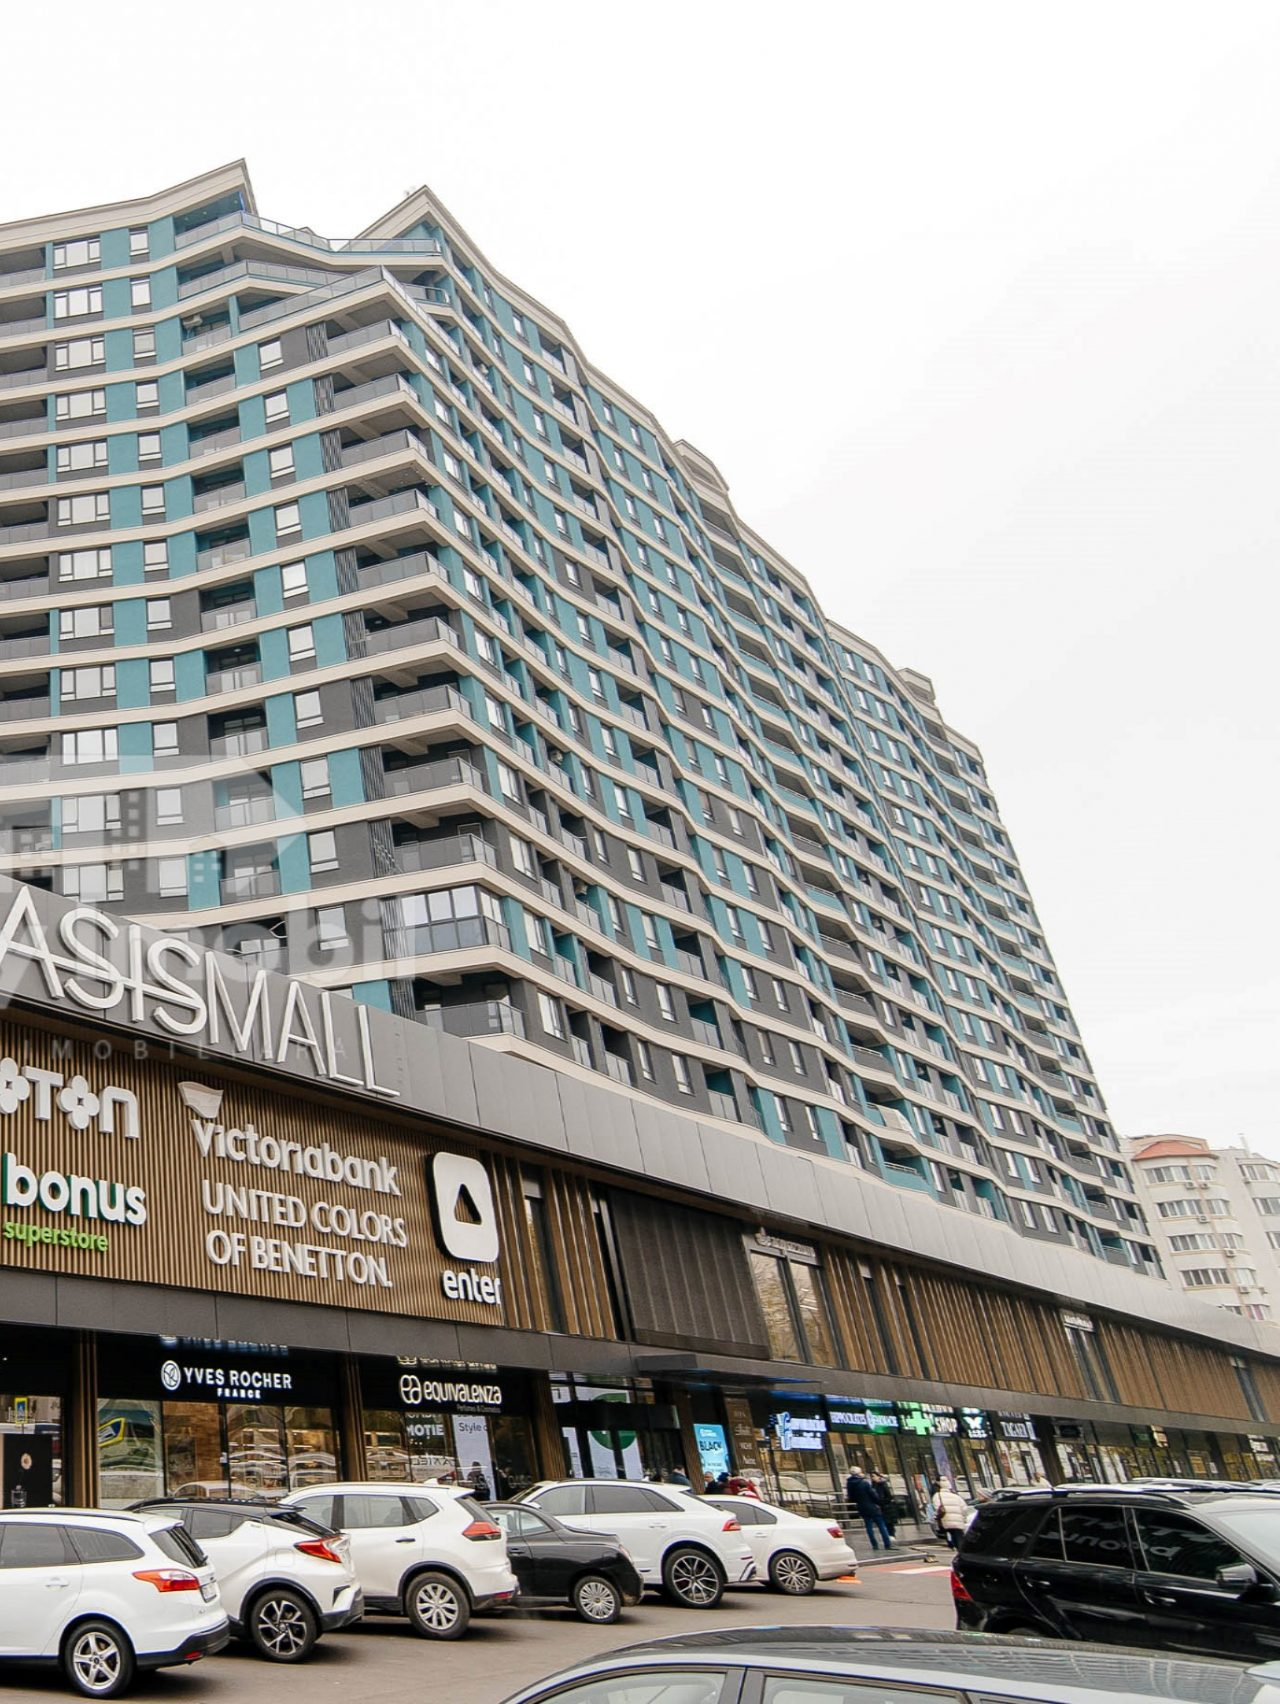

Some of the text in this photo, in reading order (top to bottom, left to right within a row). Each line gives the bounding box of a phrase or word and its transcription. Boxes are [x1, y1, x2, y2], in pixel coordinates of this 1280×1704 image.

[189, 1118, 402, 1197] Victoriabank
[1, 1152, 148, 1226] bonus
[201, 1179, 408, 1249] UNITED COLORS
[2, 1221, 109, 1252] superstore
[205, 1229, 246, 1267] OF
[442, 1267, 501, 1305] enter
[183, 1366, 293, 1389] YVES ROCHER
[217, 1387, 262, 1399] FRANCE
[458, 1422, 482, 1434] Style
